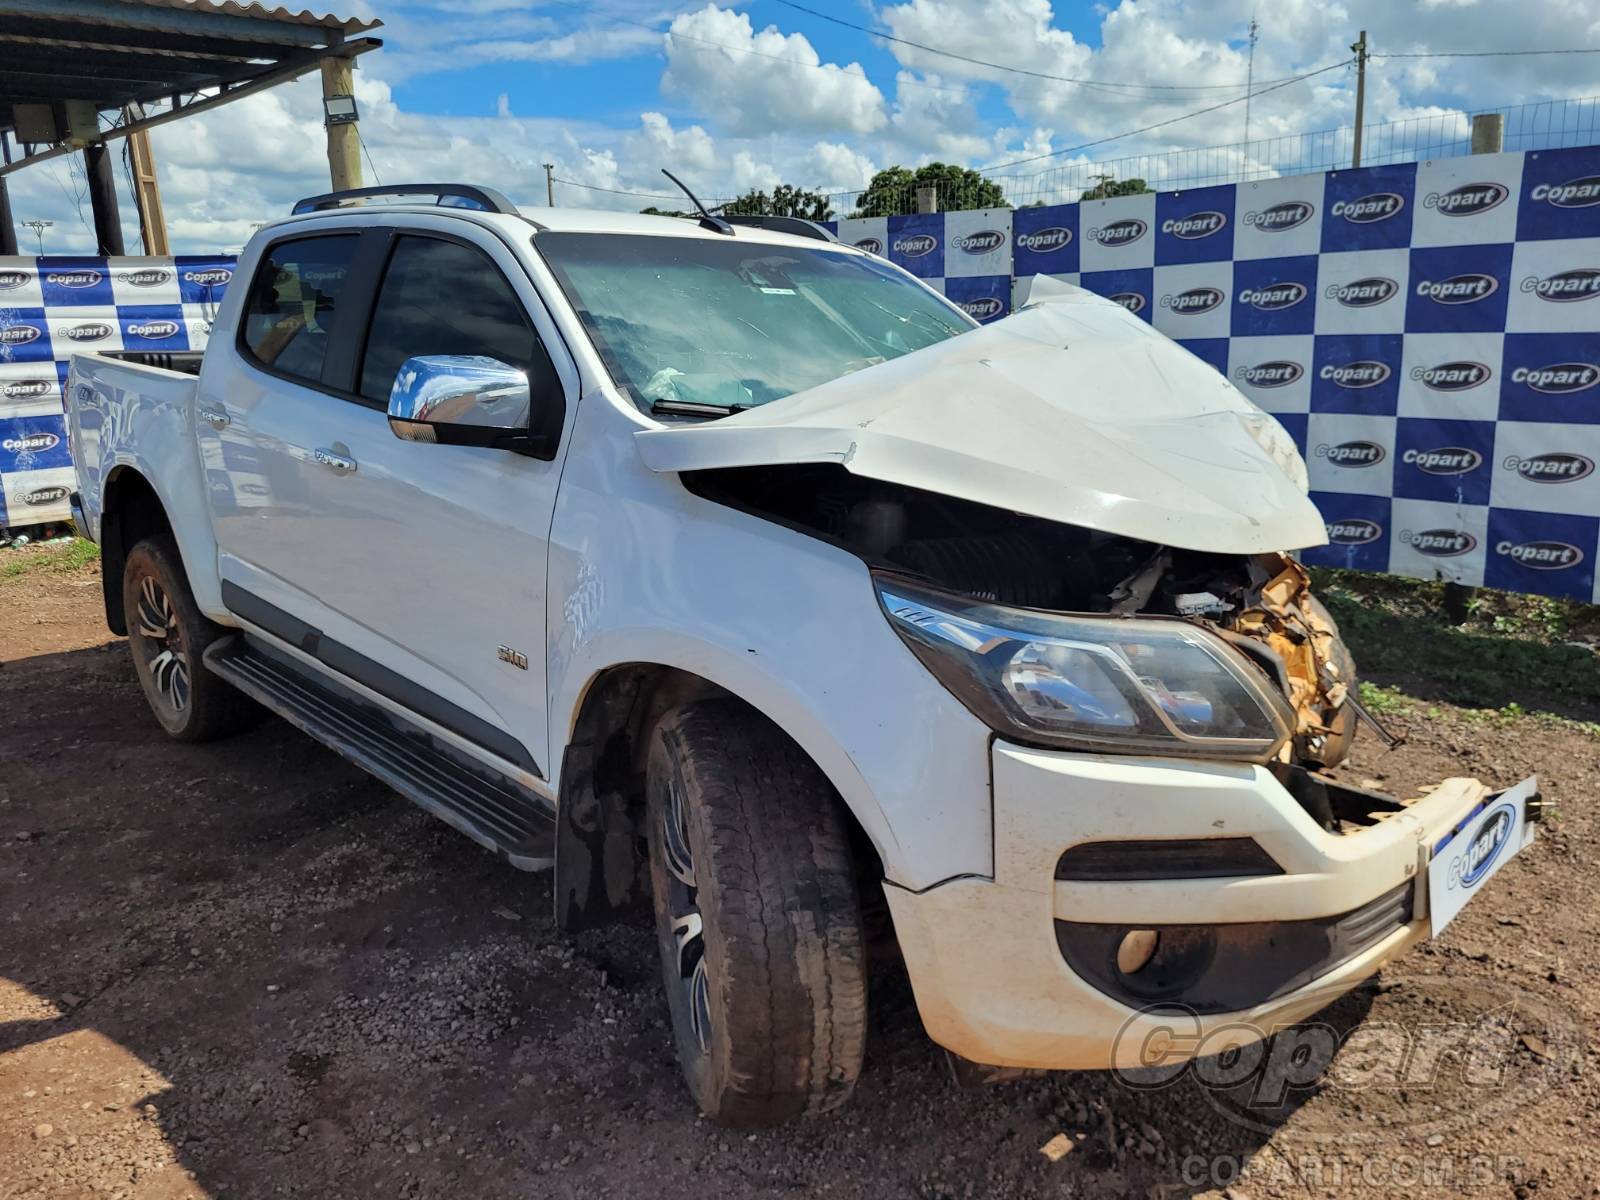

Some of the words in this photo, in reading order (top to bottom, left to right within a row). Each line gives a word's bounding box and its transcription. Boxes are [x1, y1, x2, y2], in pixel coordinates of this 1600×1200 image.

[1330, 199, 1395, 218] Copart
[1423, 188, 1496, 210] Copart
[1162, 215, 1219, 235] Copart
[1243, 205, 1304, 228] Copart
[952, 235, 997, 249] Copart
[1017, 230, 1065, 248] Copart
[1086, 224, 1140, 243] Copart
[893, 238, 930, 253] Copart
[47, 272, 95, 285] Copart
[117, 272, 162, 284] Copart
[184, 270, 229, 284] Copart
[1520, 276, 1600, 297] Copart
[1239, 286, 1299, 306] Copart
[1325, 283, 1389, 303] Copart
[1416, 279, 1488, 299] Copart
[1159, 291, 1214, 310] Copart
[58, 325, 106, 339] Copart
[127, 322, 173, 336] Copart
[1234, 365, 1294, 382] Copart
[1320, 364, 1383, 381] Copart
[1410, 365, 1480, 385] Copart
[1511, 367, 1592, 389] Copart
[2, 437, 52, 450] Copart
[1315, 443, 1377, 460] Copart
[1403, 449, 1472, 468] Copart
[1504, 456, 1582, 476] Copart
[15, 490, 62, 503] Copart
[1327, 524, 1373, 538] part
[1399, 530, 1466, 551] Copart
[1496, 541, 1574, 562] Copart
[1447, 811, 1509, 891] Copart
